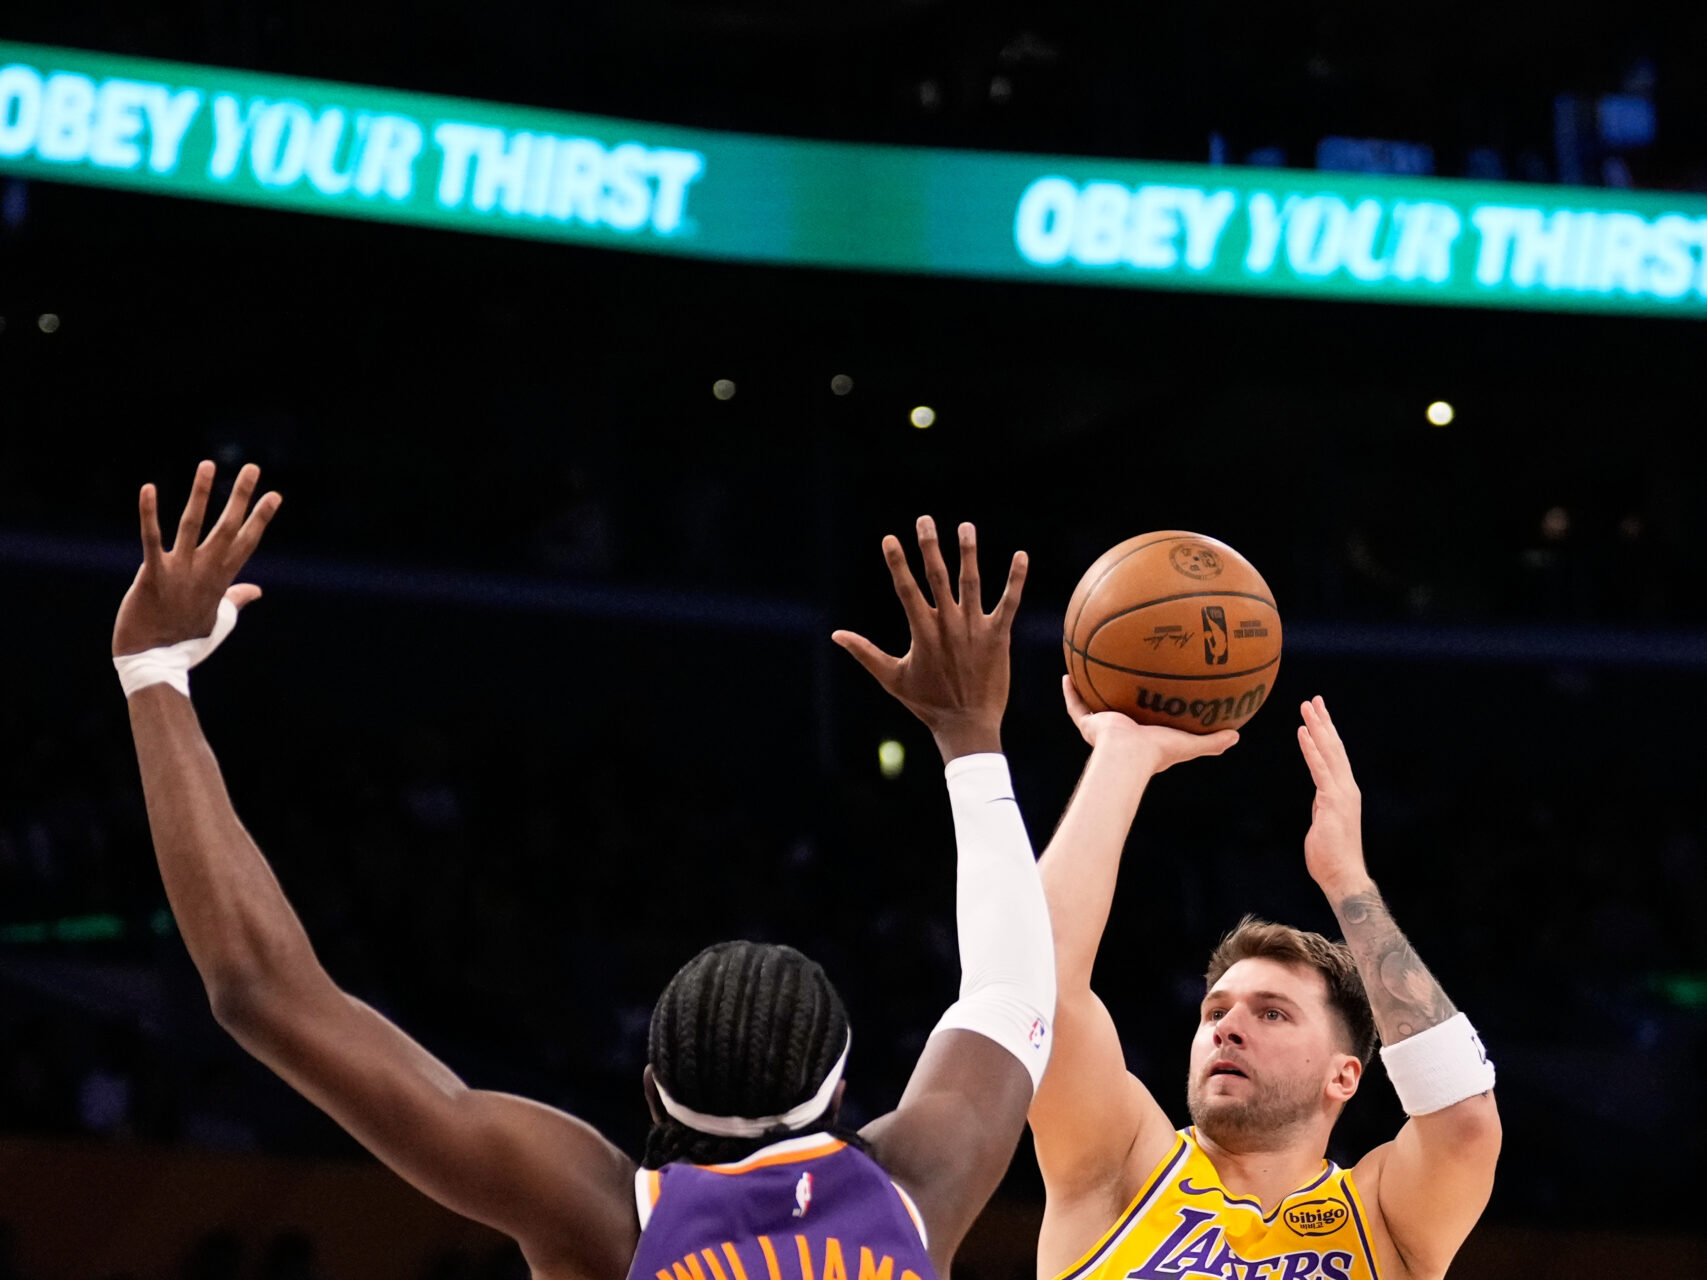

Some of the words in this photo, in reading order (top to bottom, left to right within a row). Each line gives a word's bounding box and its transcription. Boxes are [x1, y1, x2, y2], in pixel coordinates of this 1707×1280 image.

[0, 64, 201, 174] OBEY
[208, 94, 422, 200] YOUR
[433, 122, 706, 236] THIRST
[1014, 175, 1238, 273] OBEY
[1245, 190, 1462, 284] YOUR
[1471, 203, 1707, 302] THIRS
[1289, 1208, 1345, 1224] bibigo
